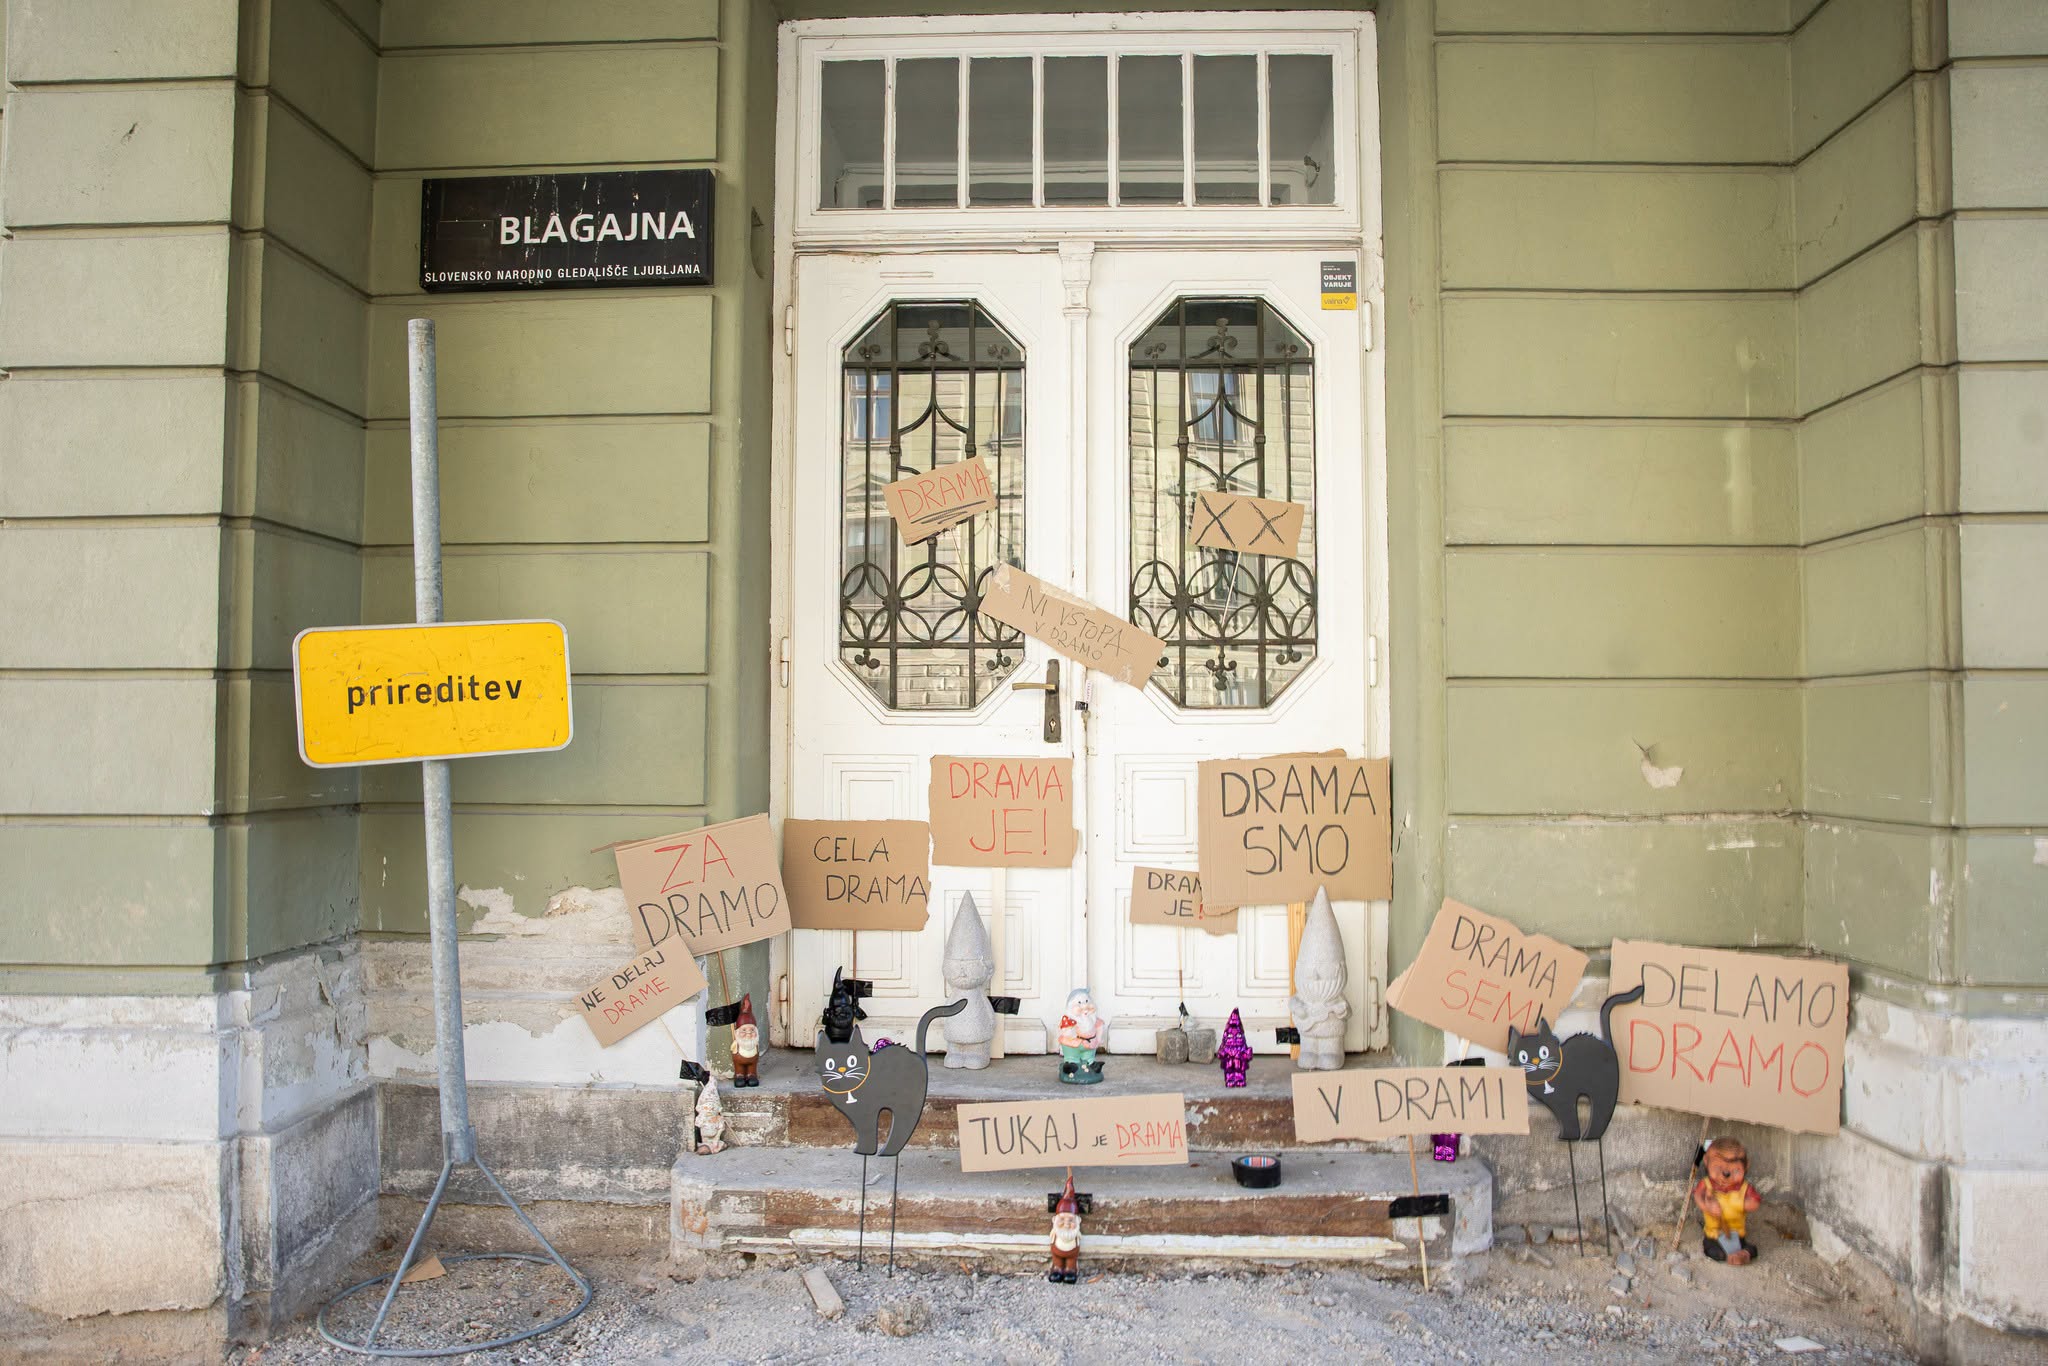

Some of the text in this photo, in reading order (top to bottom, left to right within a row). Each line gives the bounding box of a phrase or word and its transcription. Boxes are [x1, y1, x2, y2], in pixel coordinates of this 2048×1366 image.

[500, 211, 696, 245] BLAGAJNA
[424, 264, 701, 283] SLOVENSKO NARODNO GLEDALIŠČE LJUBLJANA
[897, 463, 990, 520] DRAMA
[1021, 585, 1133, 657] NI VSTOPA
[1051, 627, 1103, 661] DRAMO
[347, 675, 523, 715] prireditev
[948, 762, 1064, 802] DRAMA
[1221, 764, 1377, 818] DRAMA
[813, 836, 890, 863] CELA
[969, 808, 1048, 856] JE!
[1243, 823, 1350, 876] SMO
[654, 834, 735, 894] ZA
[826, 874, 929, 905] DRAMA
[637, 882, 779, 948] DRAMO
[580, 950, 665, 1012] NE DELAJ
[1450, 915, 1558, 999] DRAMA
[602, 975, 671, 1025] DRAME
[1640, 962, 1836, 1029] DELAMO
[1628, 1018, 1830, 1098] DRAMO
[1316, 1075, 1507, 1126] V DRAMI
[968, 1112, 1184, 1156] TUKAJ JE DRAMA
